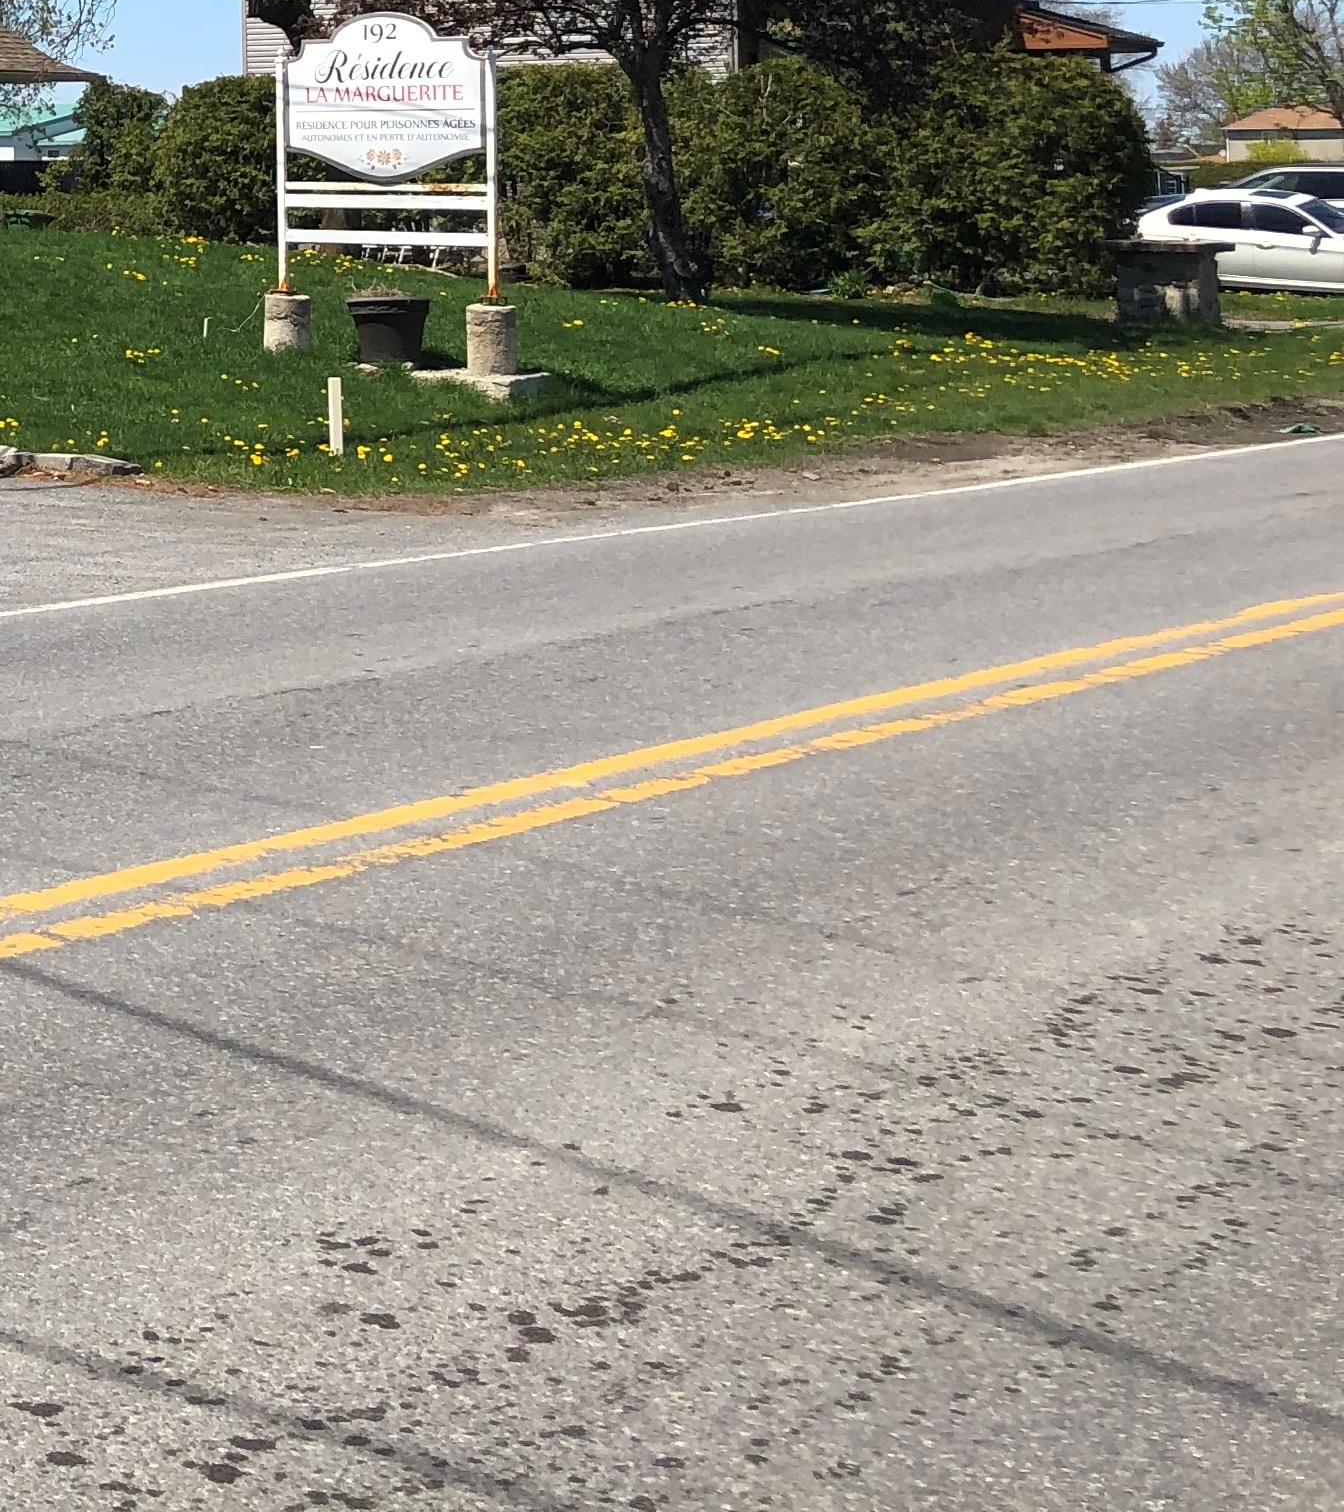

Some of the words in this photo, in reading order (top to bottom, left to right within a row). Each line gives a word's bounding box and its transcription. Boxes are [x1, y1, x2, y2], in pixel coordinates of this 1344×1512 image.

[362, 23, 398, 43] 192
[314, 48, 454, 84] Résidence
[305, 87, 328, 104] LA
[334, 84, 464, 103] MARGUERITE
[296, 120, 348, 130] RÉSIDENCE
[350, 120, 378, 130] POUR
[380, 119, 440, 129] PERSONNES
[302, 134, 353, 142] AUTONOMES
[354, 133, 365, 141] ET
[366, 133, 378, 141] EN
[379, 133, 405, 141] PERTE
